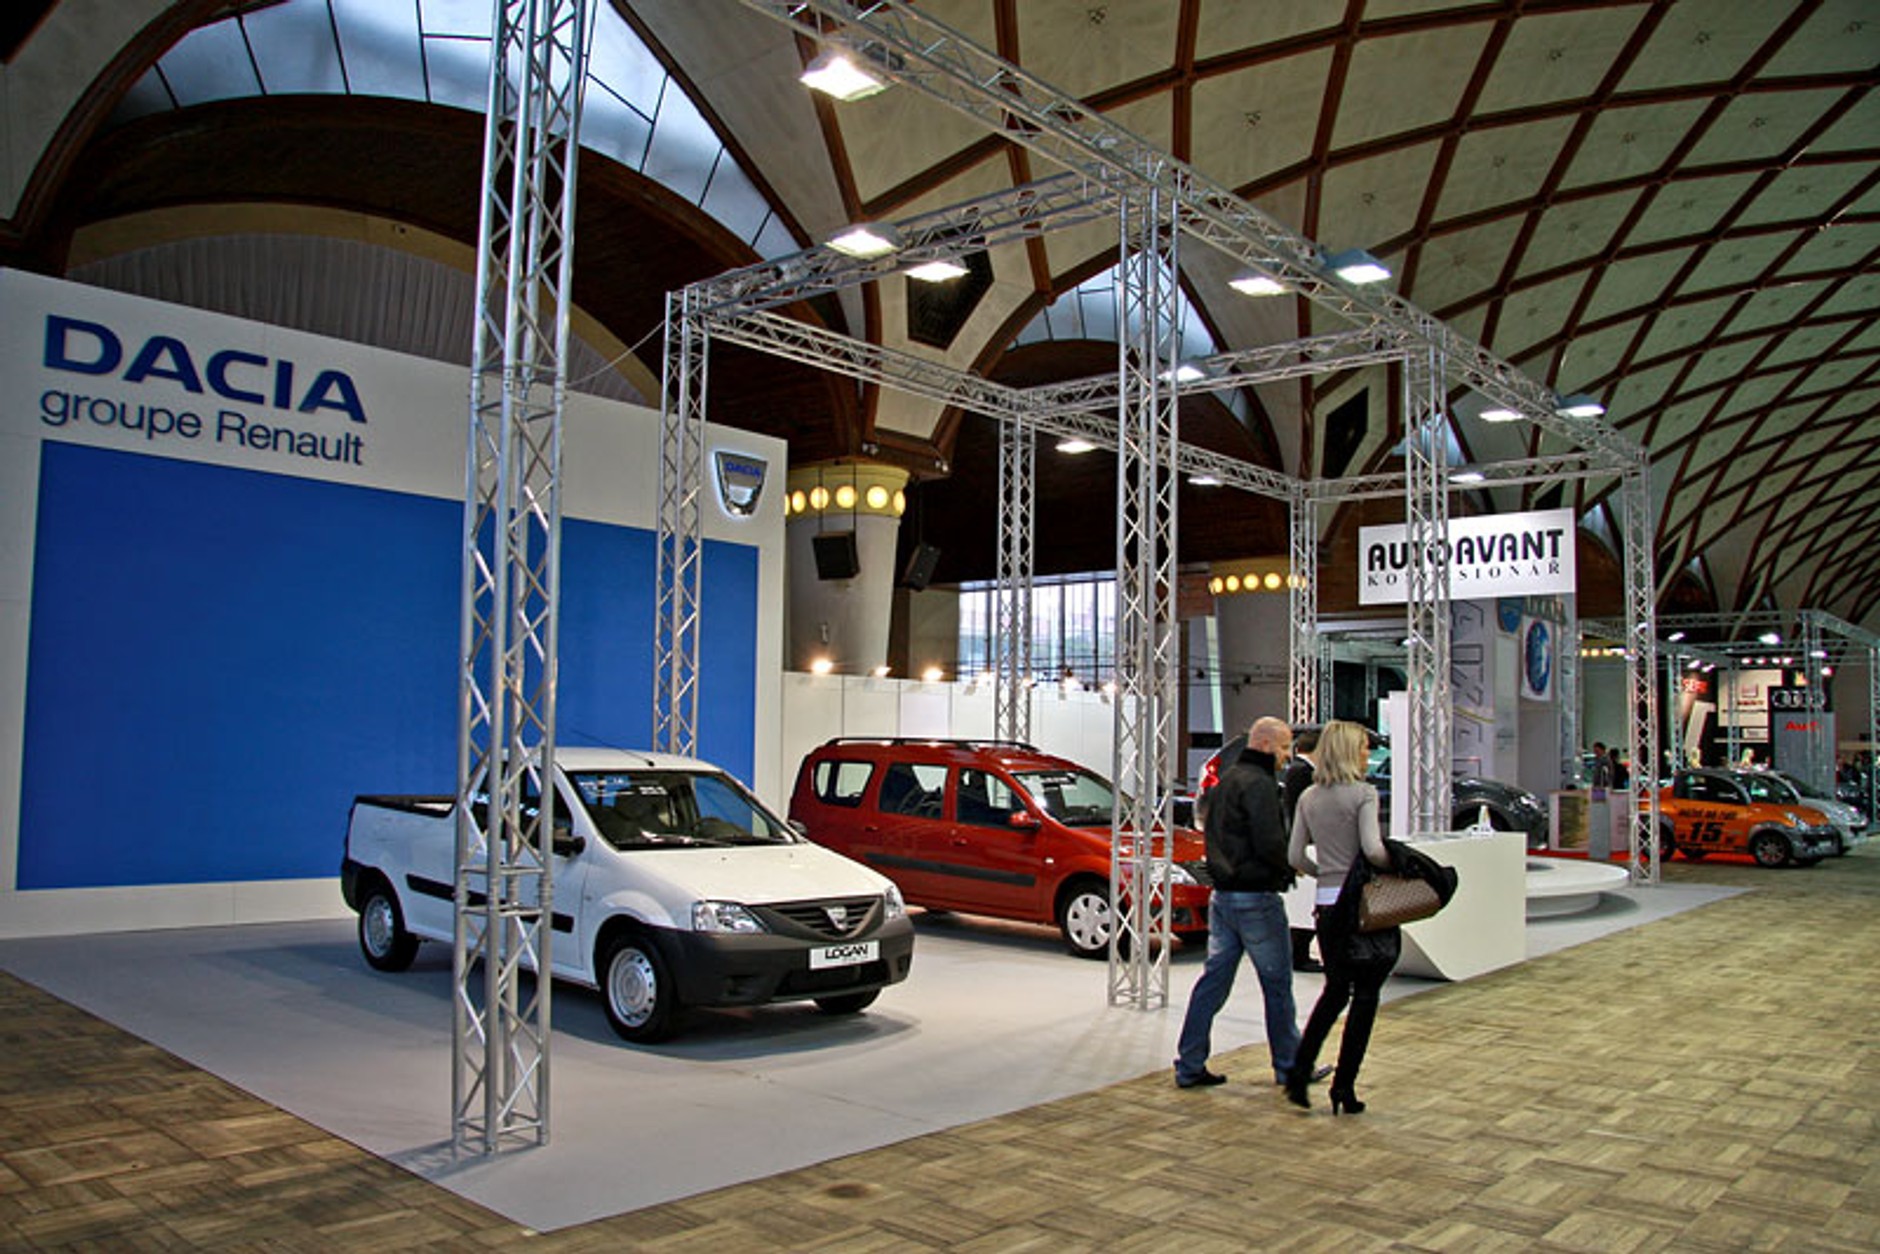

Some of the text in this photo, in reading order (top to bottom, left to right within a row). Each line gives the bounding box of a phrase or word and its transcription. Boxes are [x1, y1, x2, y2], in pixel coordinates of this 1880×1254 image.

[43, 314, 368, 424] DACIA
[40, 389, 365, 466] groupe Renault
[1690, 821, 1727, 843] 15
[825, 944, 869, 960] LOGAN
